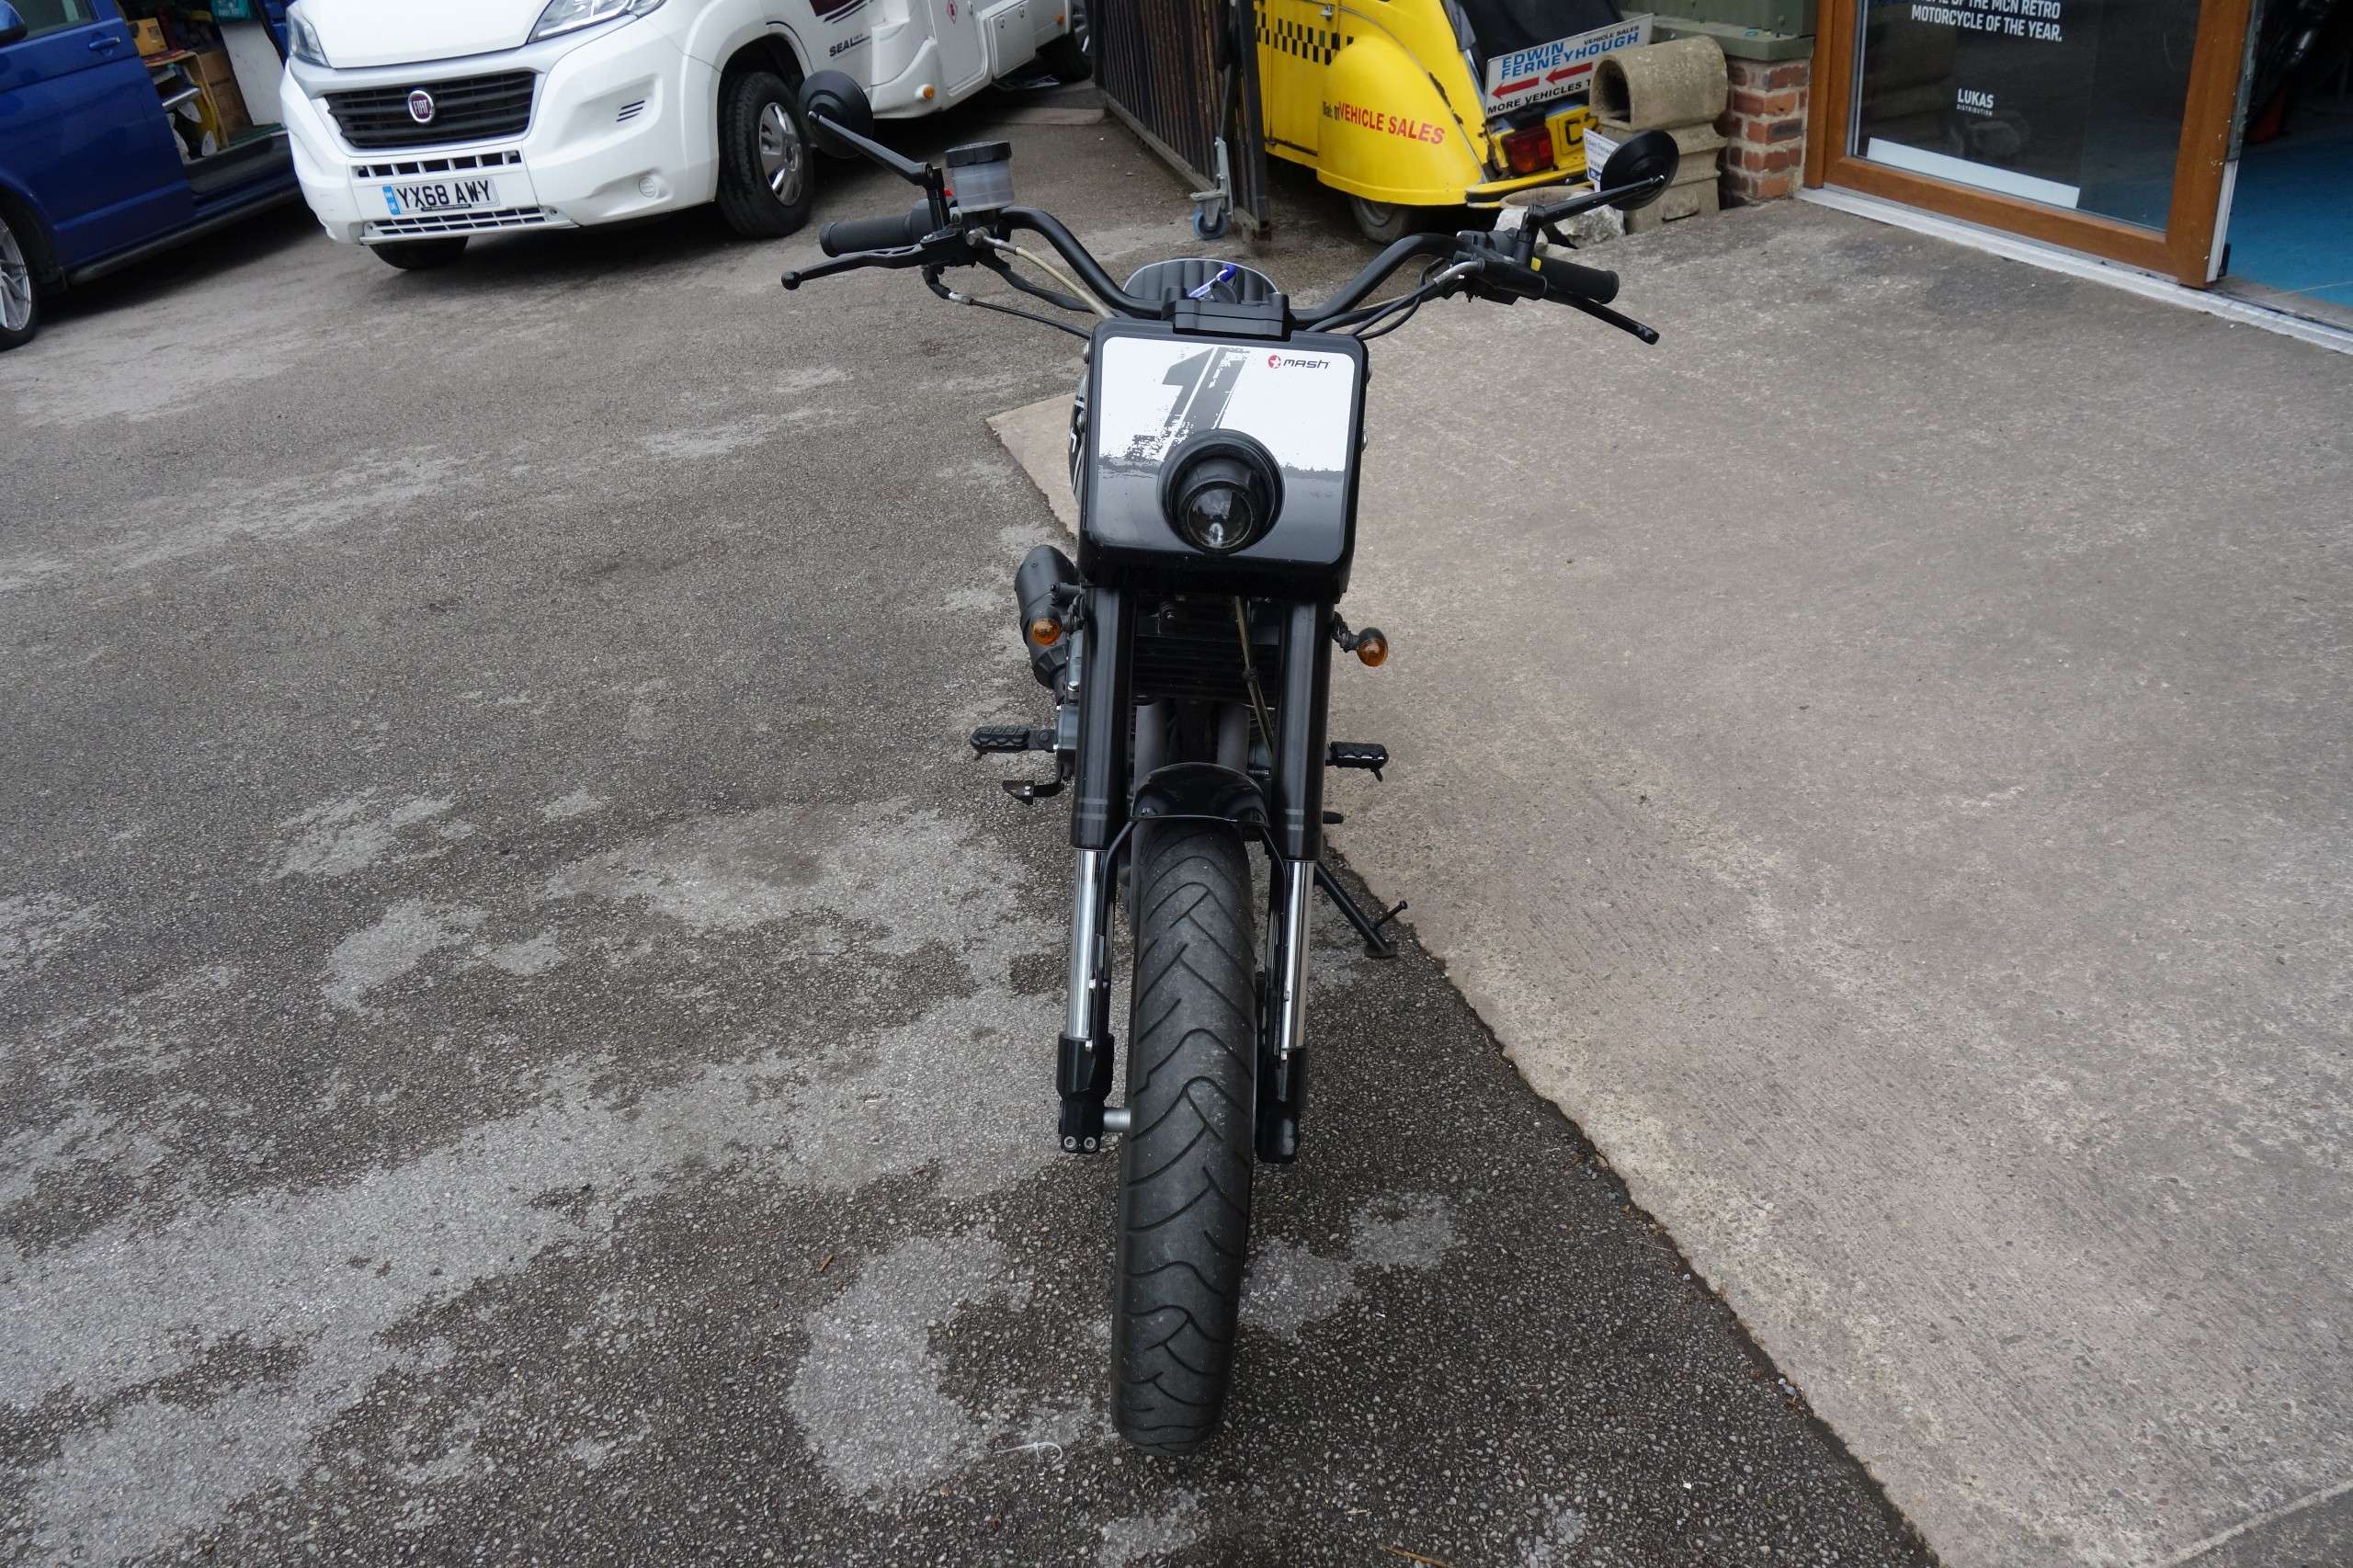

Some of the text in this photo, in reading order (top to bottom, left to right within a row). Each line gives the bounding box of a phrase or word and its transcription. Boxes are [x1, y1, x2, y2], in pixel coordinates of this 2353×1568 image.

[1911, 4, 2063, 42] MOTORCYCLE OF THE YEAR.
[1991, 0, 2019, 14] MCN
[2020, 0, 2061, 19] RETRO
[1583, 25, 1640, 46] VEHICLE SALES
[1500, 31, 1640, 81] FERNEYHOUGH
[1501, 41, 1565, 70] EDWIN
[413, 99, 429, 116] FIAT
[1486, 97, 1522, 116] MORE
[1525, 80, 1583, 105] VEHICLES
[1957, 87, 1995, 109] LUKAS
[1338, 102, 1385, 132] VEHICLE
[1388, 116, 1446, 145] SALES
[396, 179, 491, 210] YX68 AWY
